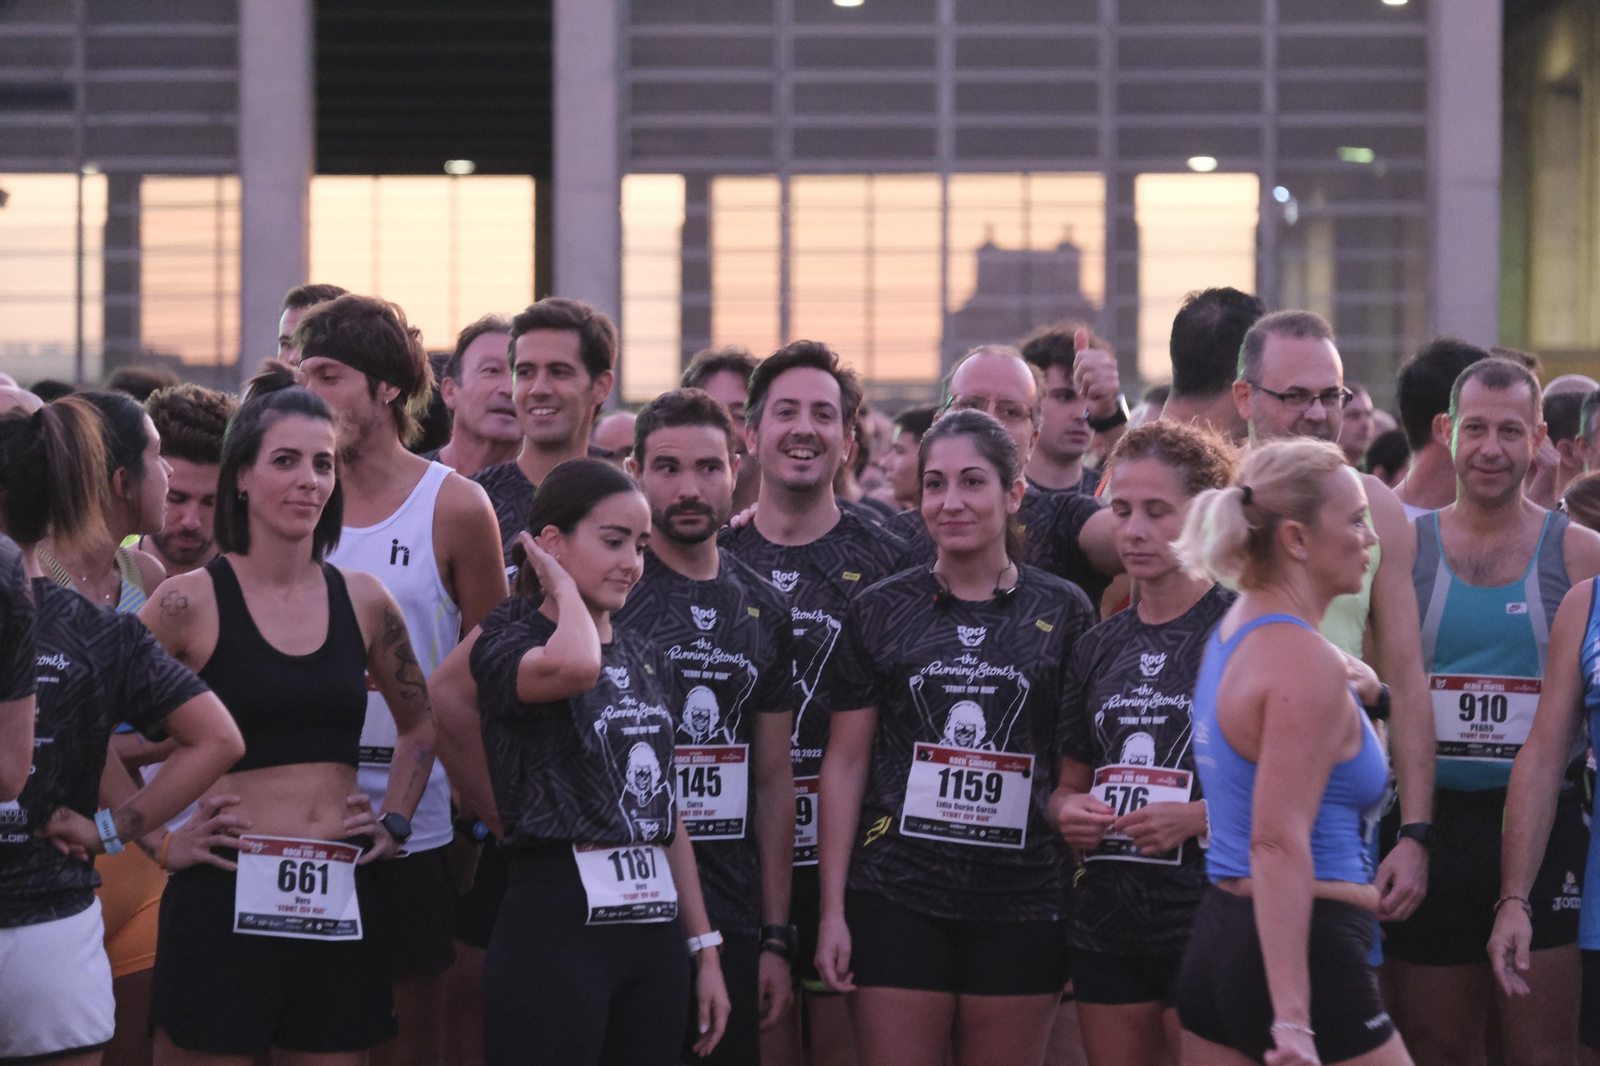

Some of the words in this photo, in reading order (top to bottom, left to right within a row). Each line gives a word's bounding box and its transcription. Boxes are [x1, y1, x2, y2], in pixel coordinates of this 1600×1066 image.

[772, 570, 800, 585] Rock
[690, 605, 718, 620] Rock
[957, 625, 987, 638] Rock
[690, 637, 713, 650] the
[36, 654, 70, 671] ones
[664, 645, 711, 669] Running
[710, 647, 751, 668] Stones
[953, 653, 979, 665] the
[1140, 652, 1168, 666] Rock
[921, 660, 976, 684] Running
[976, 661, 1022, 680] Stones
[1131, 683, 1154, 696] the
[1102, 694, 1150, 715] Running
[1148, 692, 1191, 709] Stones
[1459, 692, 1508, 723] 910
[1470, 724, 1494, 733] PEDRO
[801, 749, 822, 758] 2022
[949, 756, 967, 766] ROCK
[968, 758, 997, 769] GARAGE
[678, 766, 722, 798] 145
[938, 767, 1003, 804] 1159
[936, 801, 952, 809] Lidia
[1104, 786, 1149, 817] 576
[796, 796, 813, 826] 9
[607, 847, 657, 882] 1187
[278, 859, 329, 895] 661
[1552, 896, 1582, 911] JOM
